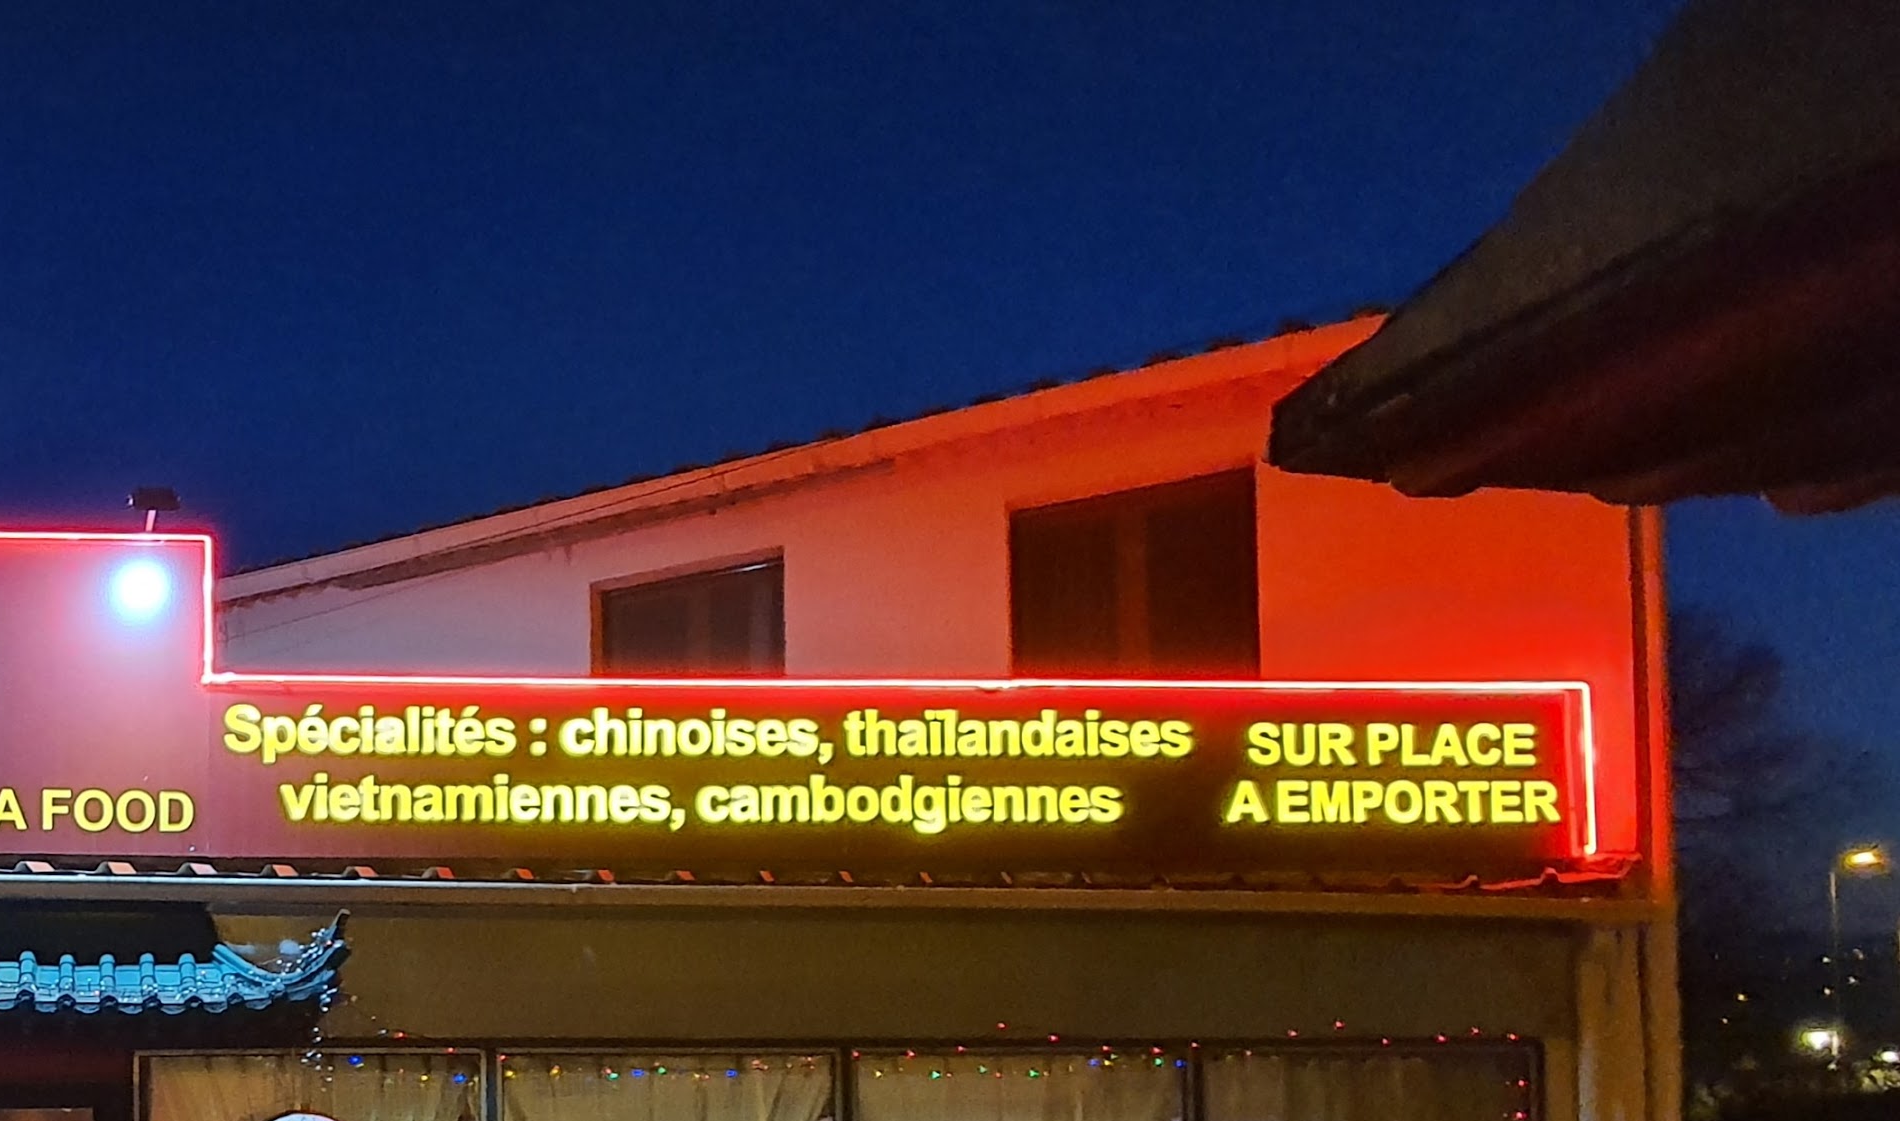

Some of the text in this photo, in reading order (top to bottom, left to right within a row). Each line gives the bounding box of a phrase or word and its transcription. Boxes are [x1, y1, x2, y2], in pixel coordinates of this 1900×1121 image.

[222, 704, 517, 763] Spécialités
[557, 707, 834, 765] chinoises,
[844, 709, 1193, 758] thaïlandaises
[1247, 722, 1536, 766] SUR PLACE
[40, 788, 195, 833] FOOD
[280, 773, 1125, 834] vietnamiennes, cambodgiennes
[1227, 779, 1560, 823] A EMPORTER
